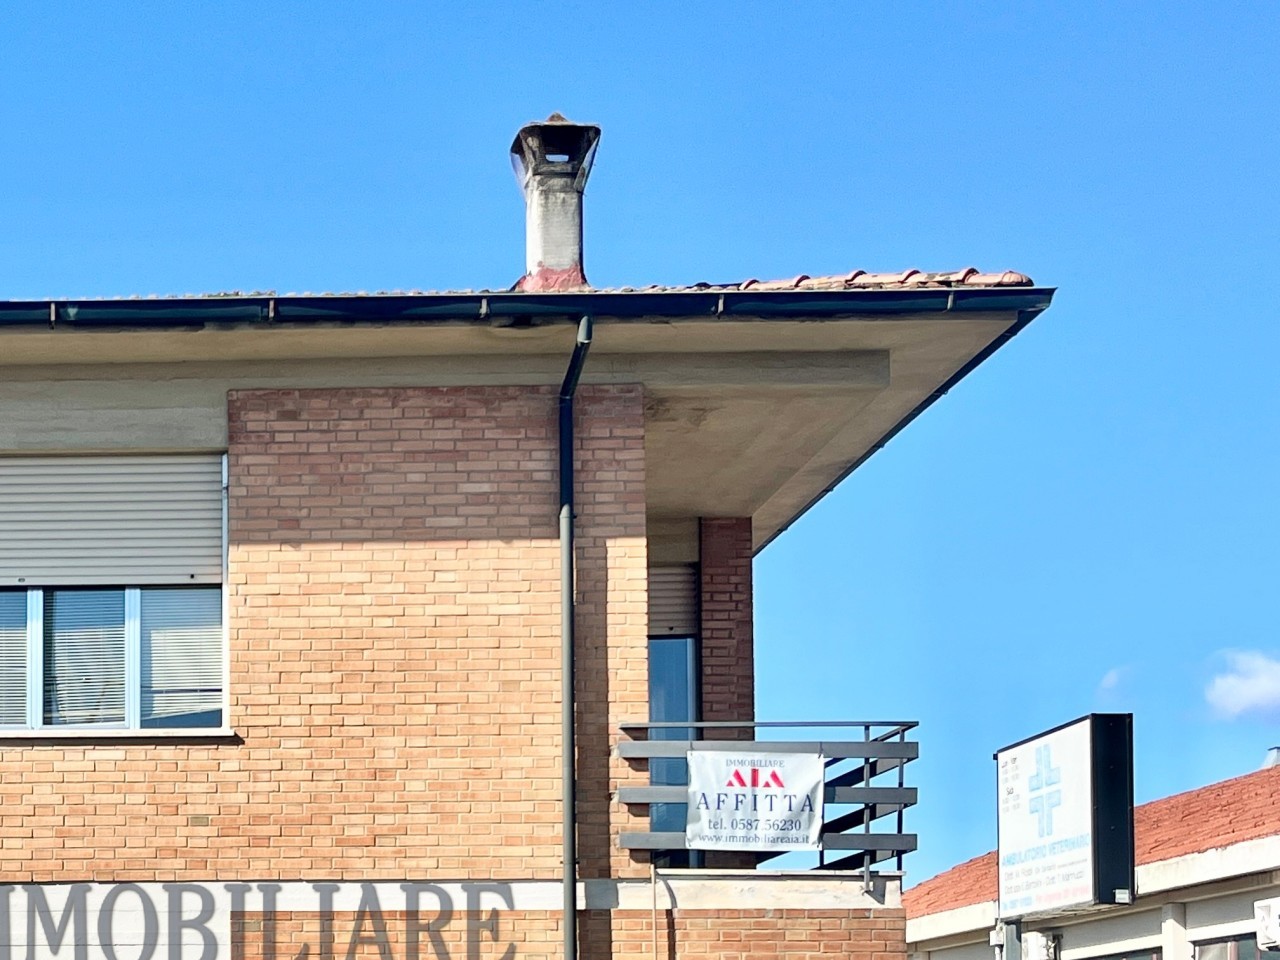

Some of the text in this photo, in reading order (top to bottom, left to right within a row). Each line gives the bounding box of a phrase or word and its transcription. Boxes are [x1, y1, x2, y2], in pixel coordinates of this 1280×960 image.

[725, 759, 785, 768] IMMOBILIARE
[726, 768, 785, 788] AIA
[696, 792, 815, 813] AFFITTA
[708, 818, 727, 831] tel.
